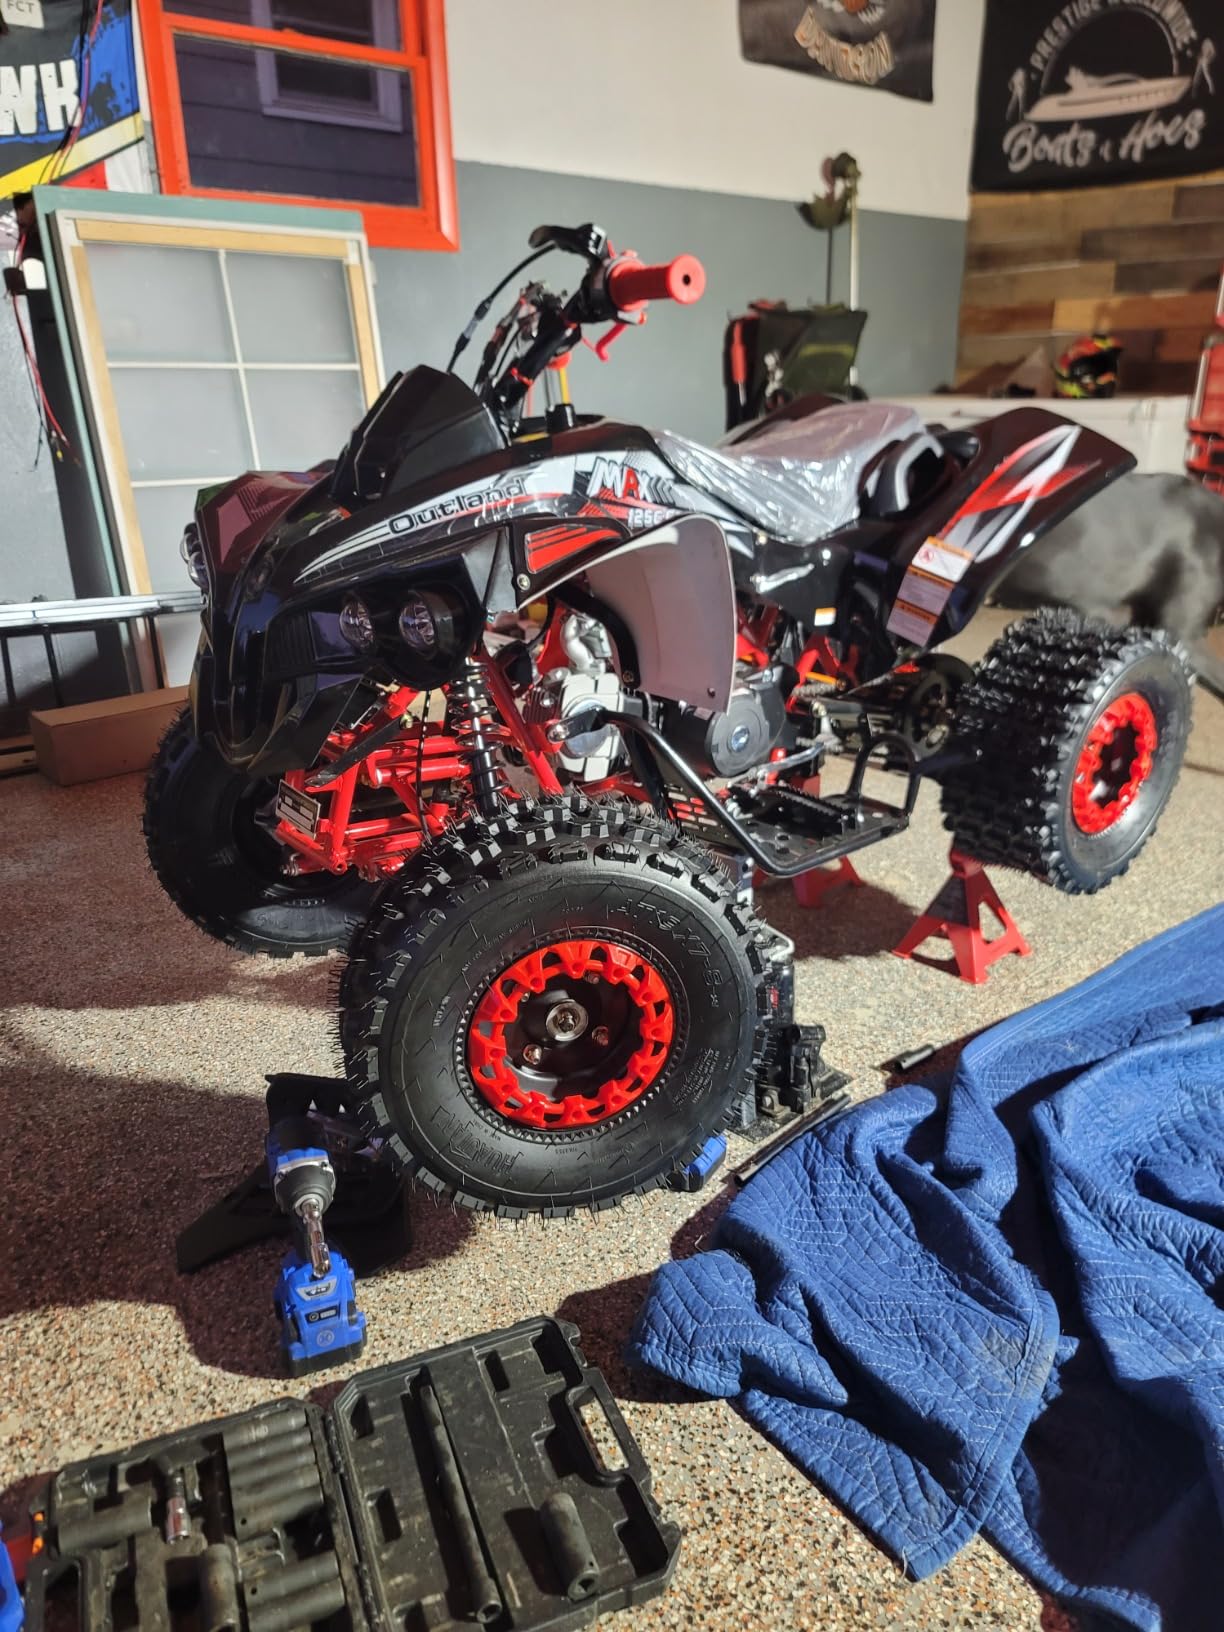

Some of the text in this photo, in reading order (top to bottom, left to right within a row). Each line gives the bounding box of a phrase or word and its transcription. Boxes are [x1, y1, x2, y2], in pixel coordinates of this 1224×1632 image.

[1003, 121, 1096, 173] Boats
[1119, 108, 1206, 163] Hoes
[388, 477, 527, 534] Outland
[586, 456, 654, 503] MAX
